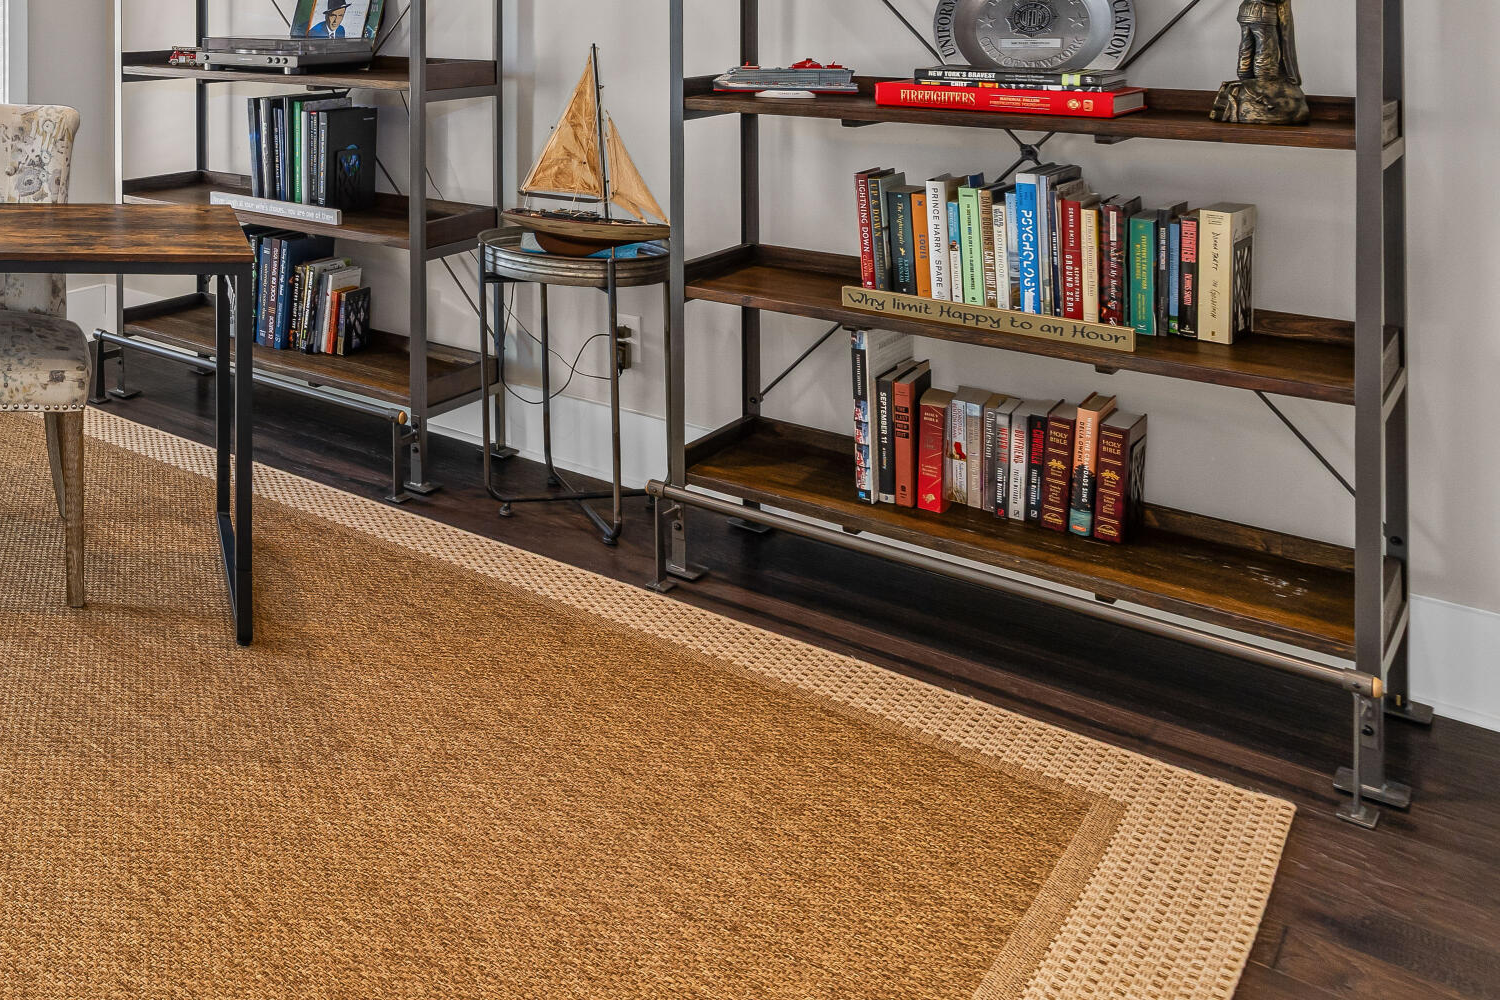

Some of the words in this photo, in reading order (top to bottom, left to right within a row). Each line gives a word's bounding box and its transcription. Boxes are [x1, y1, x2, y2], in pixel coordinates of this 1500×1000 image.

[1053, 37, 1085, 64] YORK
[968, 71, 996, 79] BRAVEST
[899, 89, 976, 106] FIREFIGHTERS
[858, 179, 868, 224] LIGHTNING
[870, 183, 878, 196] UP
[931, 187, 940, 221] PRINCE
[981, 197, 991, 214] DAVID
[872, 208, 882, 238] DOWN
[896, 213, 905, 245] Nightingale
[982, 217, 992, 245] GOGGINS
[862, 226, 870, 252] DOWN
[933, 223, 941, 254] HARRY
[1181, 220, 1197, 263] FIREFIGHTERS
[984, 250, 994, 269] CAN'T
[996, 230, 1004, 278] BROTHERHOOD
[1021, 210, 1036, 296] PSYCHOLOGY
[934, 259, 943, 288] SPARE
[985, 271, 995, 288] HURT
[1065, 254, 1073, 287] GROUND
[1110, 269, 1117, 277] My
[987, 290, 996, 300] ME
[1066, 291, 1074, 312] ZERO
[848, 292, 886, 310] Why
[892, 298, 932, 314] limit
[939, 305, 1001, 329] Happy
[1010, 316, 1033, 330] to
[1040, 324, 1064, 337] an
[1072, 325, 1126, 343] Hour
[881, 436, 888, 444] 11
[985, 411, 995, 458] Charleston
[998, 427, 1009, 449] NEVER
[1013, 429, 1025, 464] BOYFRIEND
[1031, 429, 1044, 465] COWORKER
[1049, 436, 1068, 446] BIBLE
[1050, 430, 1069, 440] HOLY
[1102, 439, 1122, 448] HOLY
[997, 452, 1009, 463] LIE
[1102, 446, 1121, 456] BIBLE
[1082, 453, 1090, 487] CRAWDADS
